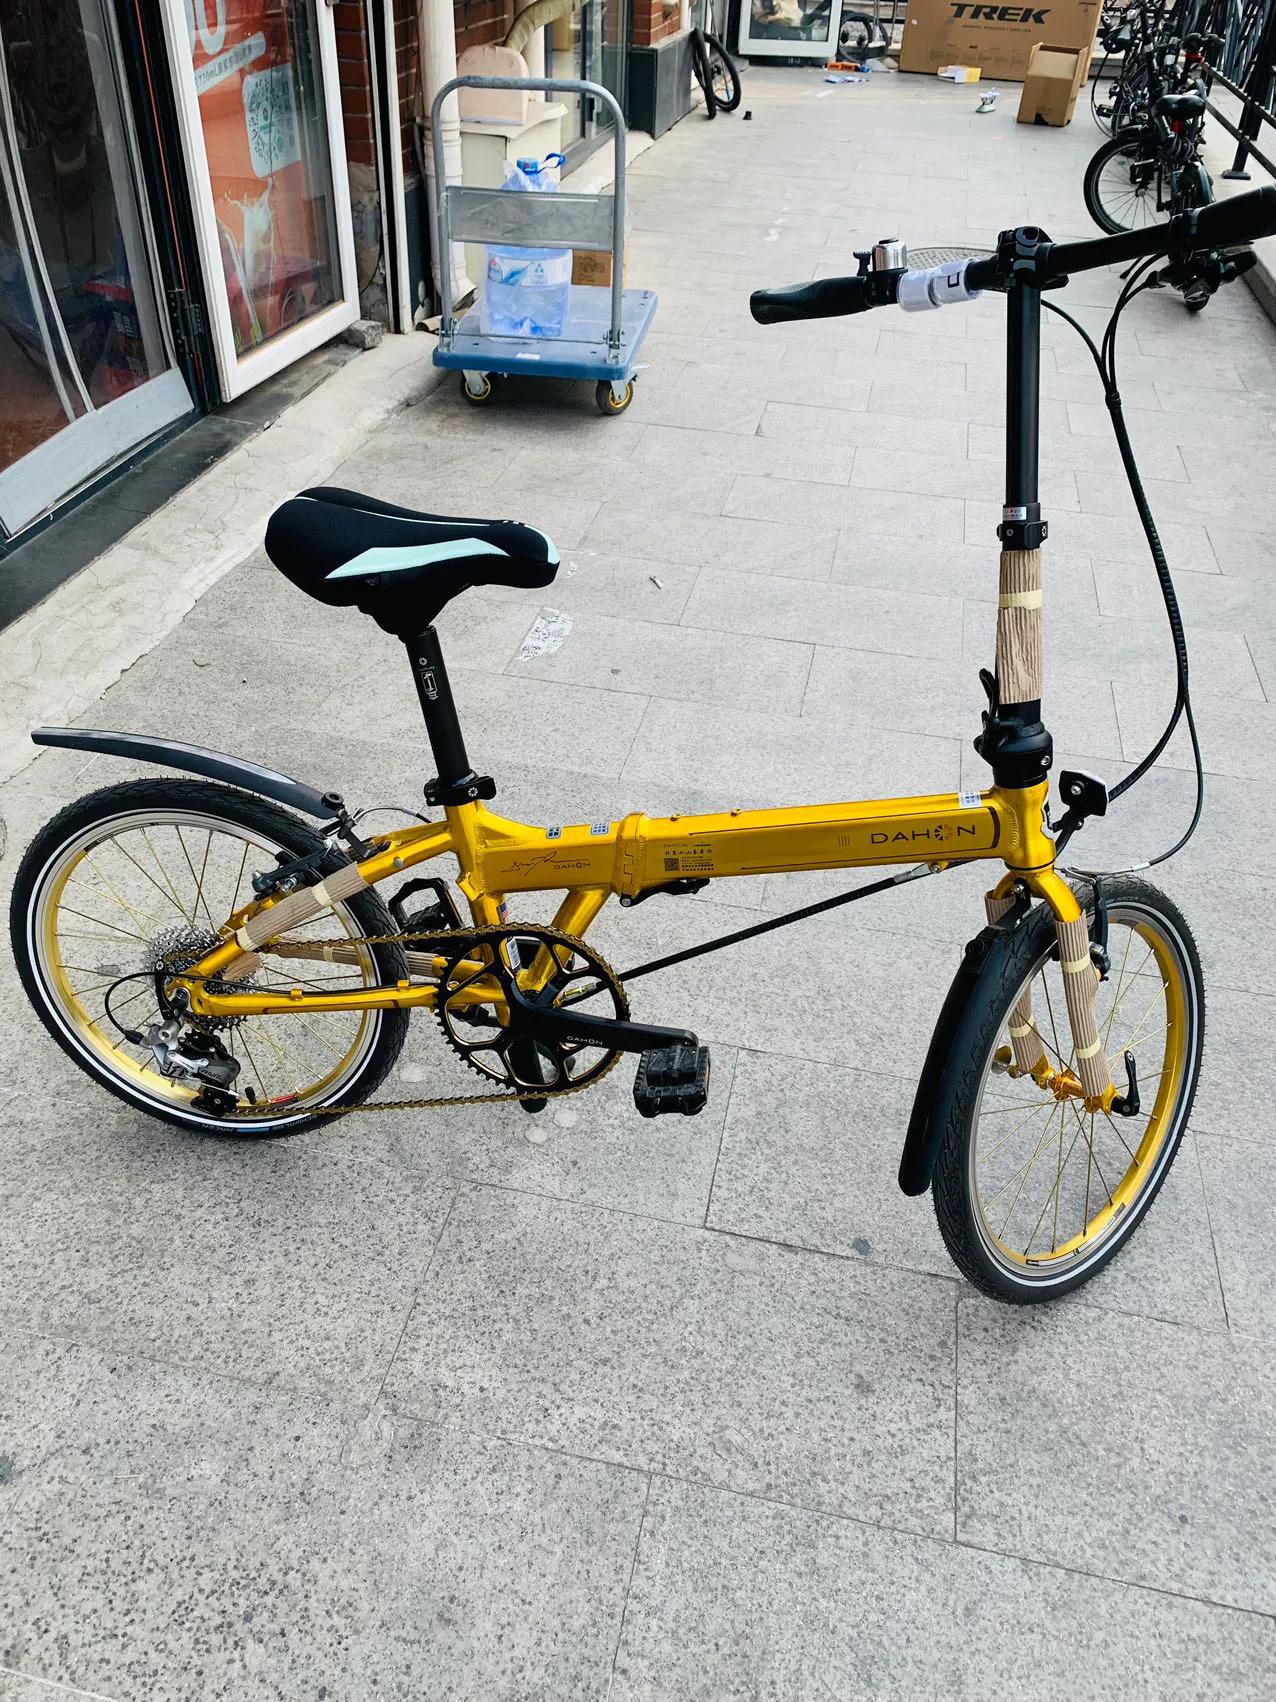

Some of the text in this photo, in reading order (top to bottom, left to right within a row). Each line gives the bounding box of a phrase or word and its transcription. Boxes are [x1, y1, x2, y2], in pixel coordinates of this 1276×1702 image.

[950, 2, 1051, 25] TREK
[871, 824, 976, 845] DAHON
[553, 861, 591, 871] DAHON
[566, 1035, 603, 1046] DAHON
